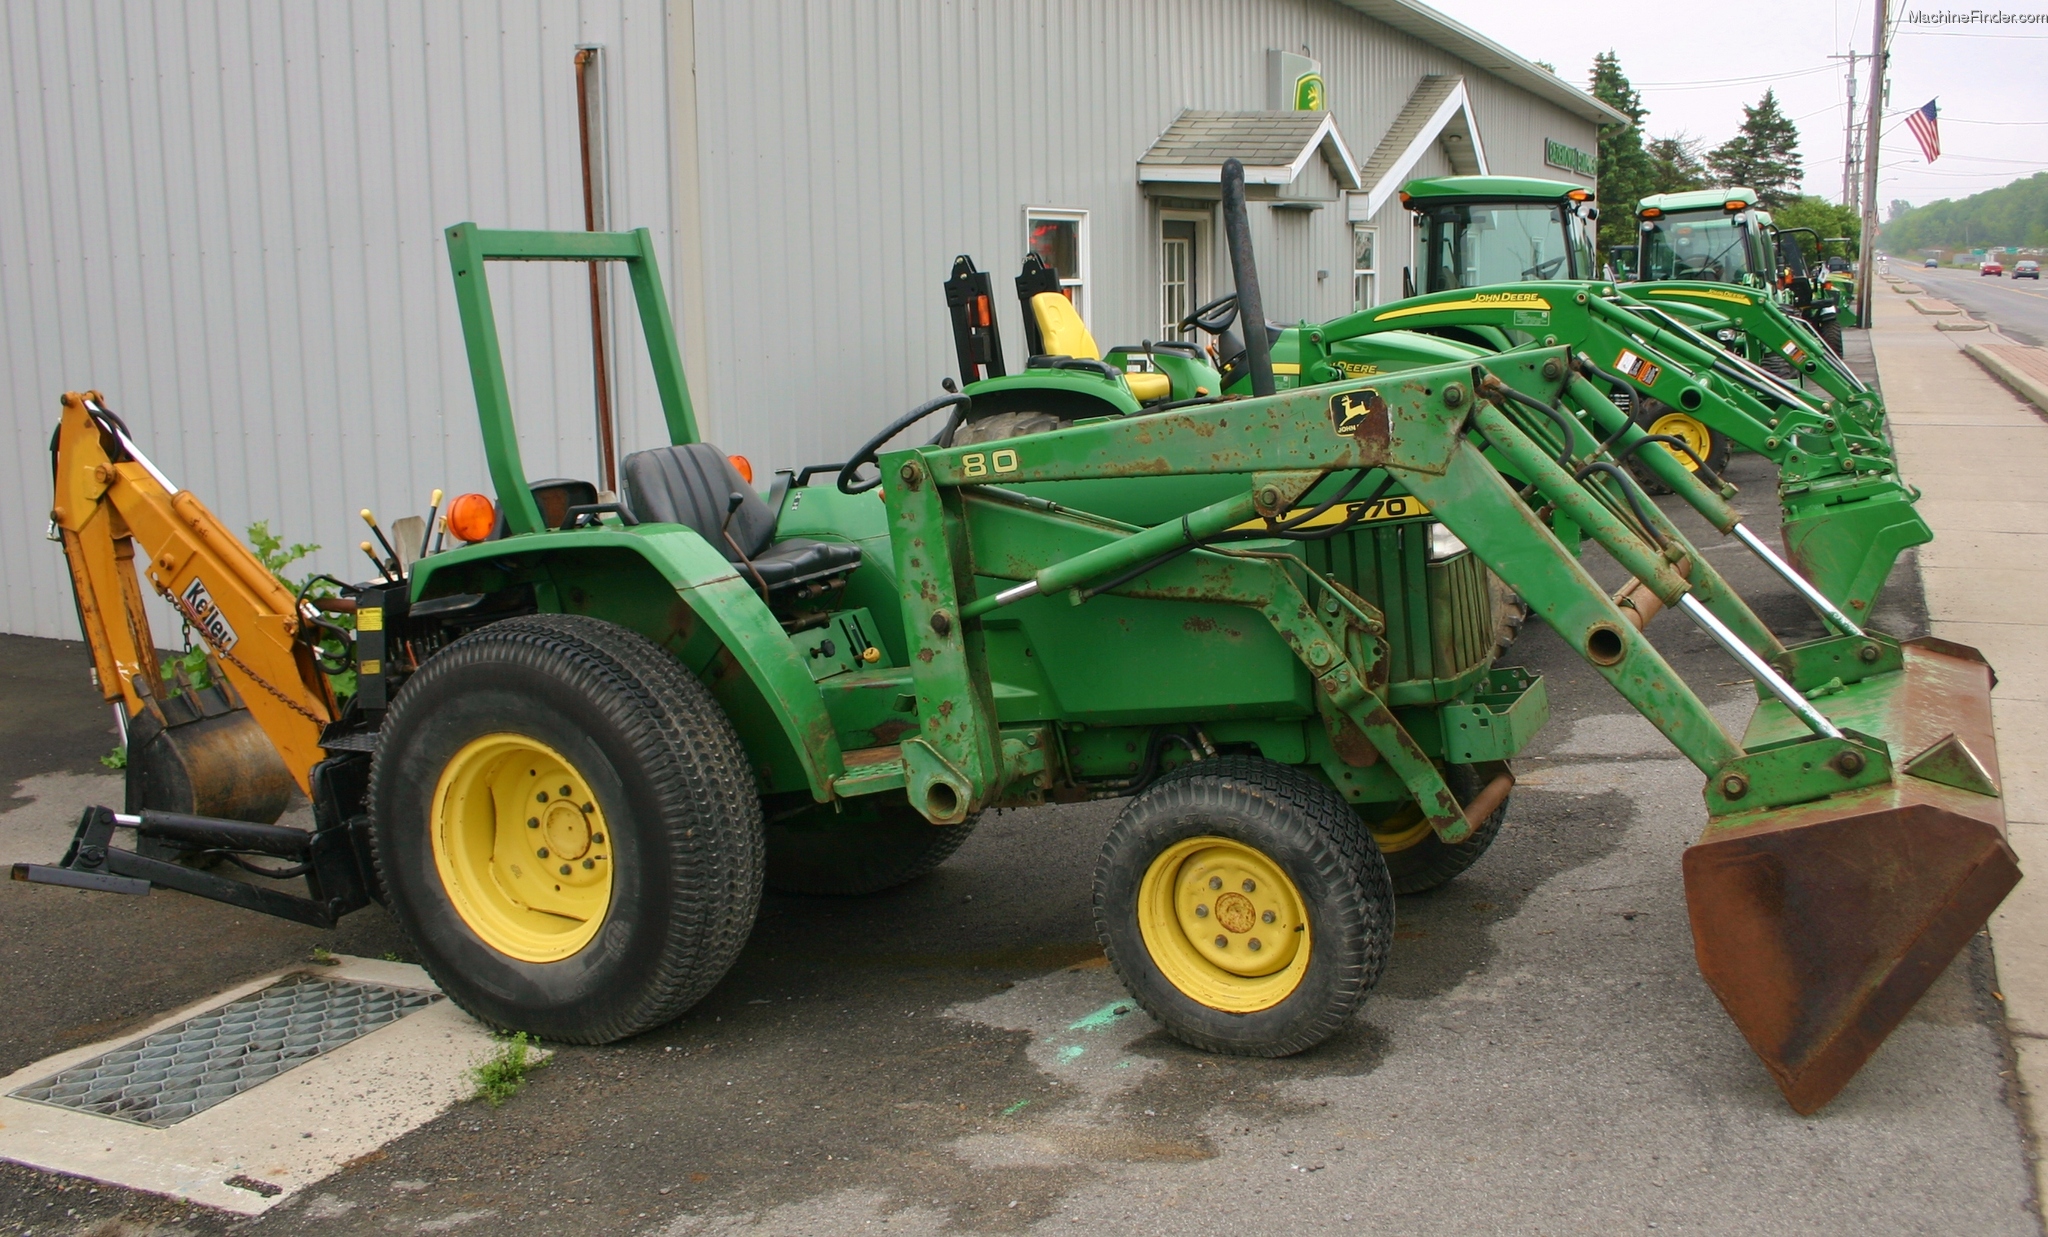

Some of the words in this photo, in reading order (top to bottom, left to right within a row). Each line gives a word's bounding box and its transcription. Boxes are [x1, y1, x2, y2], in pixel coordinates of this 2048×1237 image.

[1471, 292, 1500, 302] JOHN
[1501, 292, 1539, 302] DEERE
[962, 449, 1018, 477] 80
